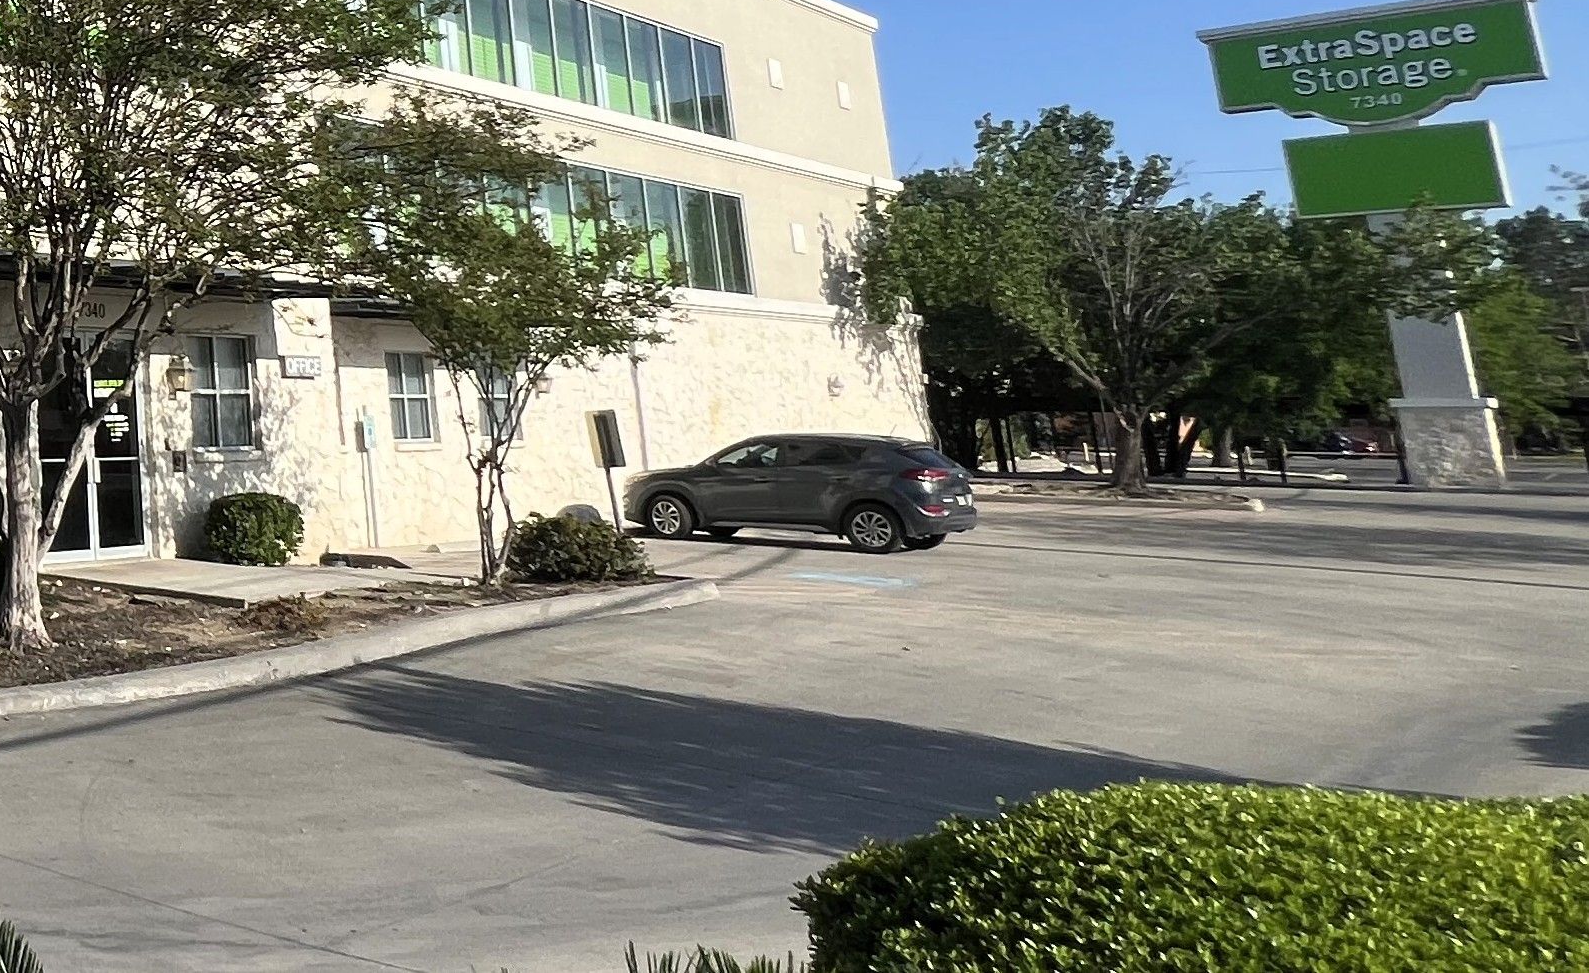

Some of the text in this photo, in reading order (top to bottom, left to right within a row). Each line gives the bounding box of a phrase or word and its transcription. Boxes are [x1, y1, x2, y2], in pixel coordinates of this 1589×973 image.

[1257, 23, 1478, 70] ExtraSpace
[1349, 92, 1403, 109] 7340
[286, 357, 322, 375] OFFICE
